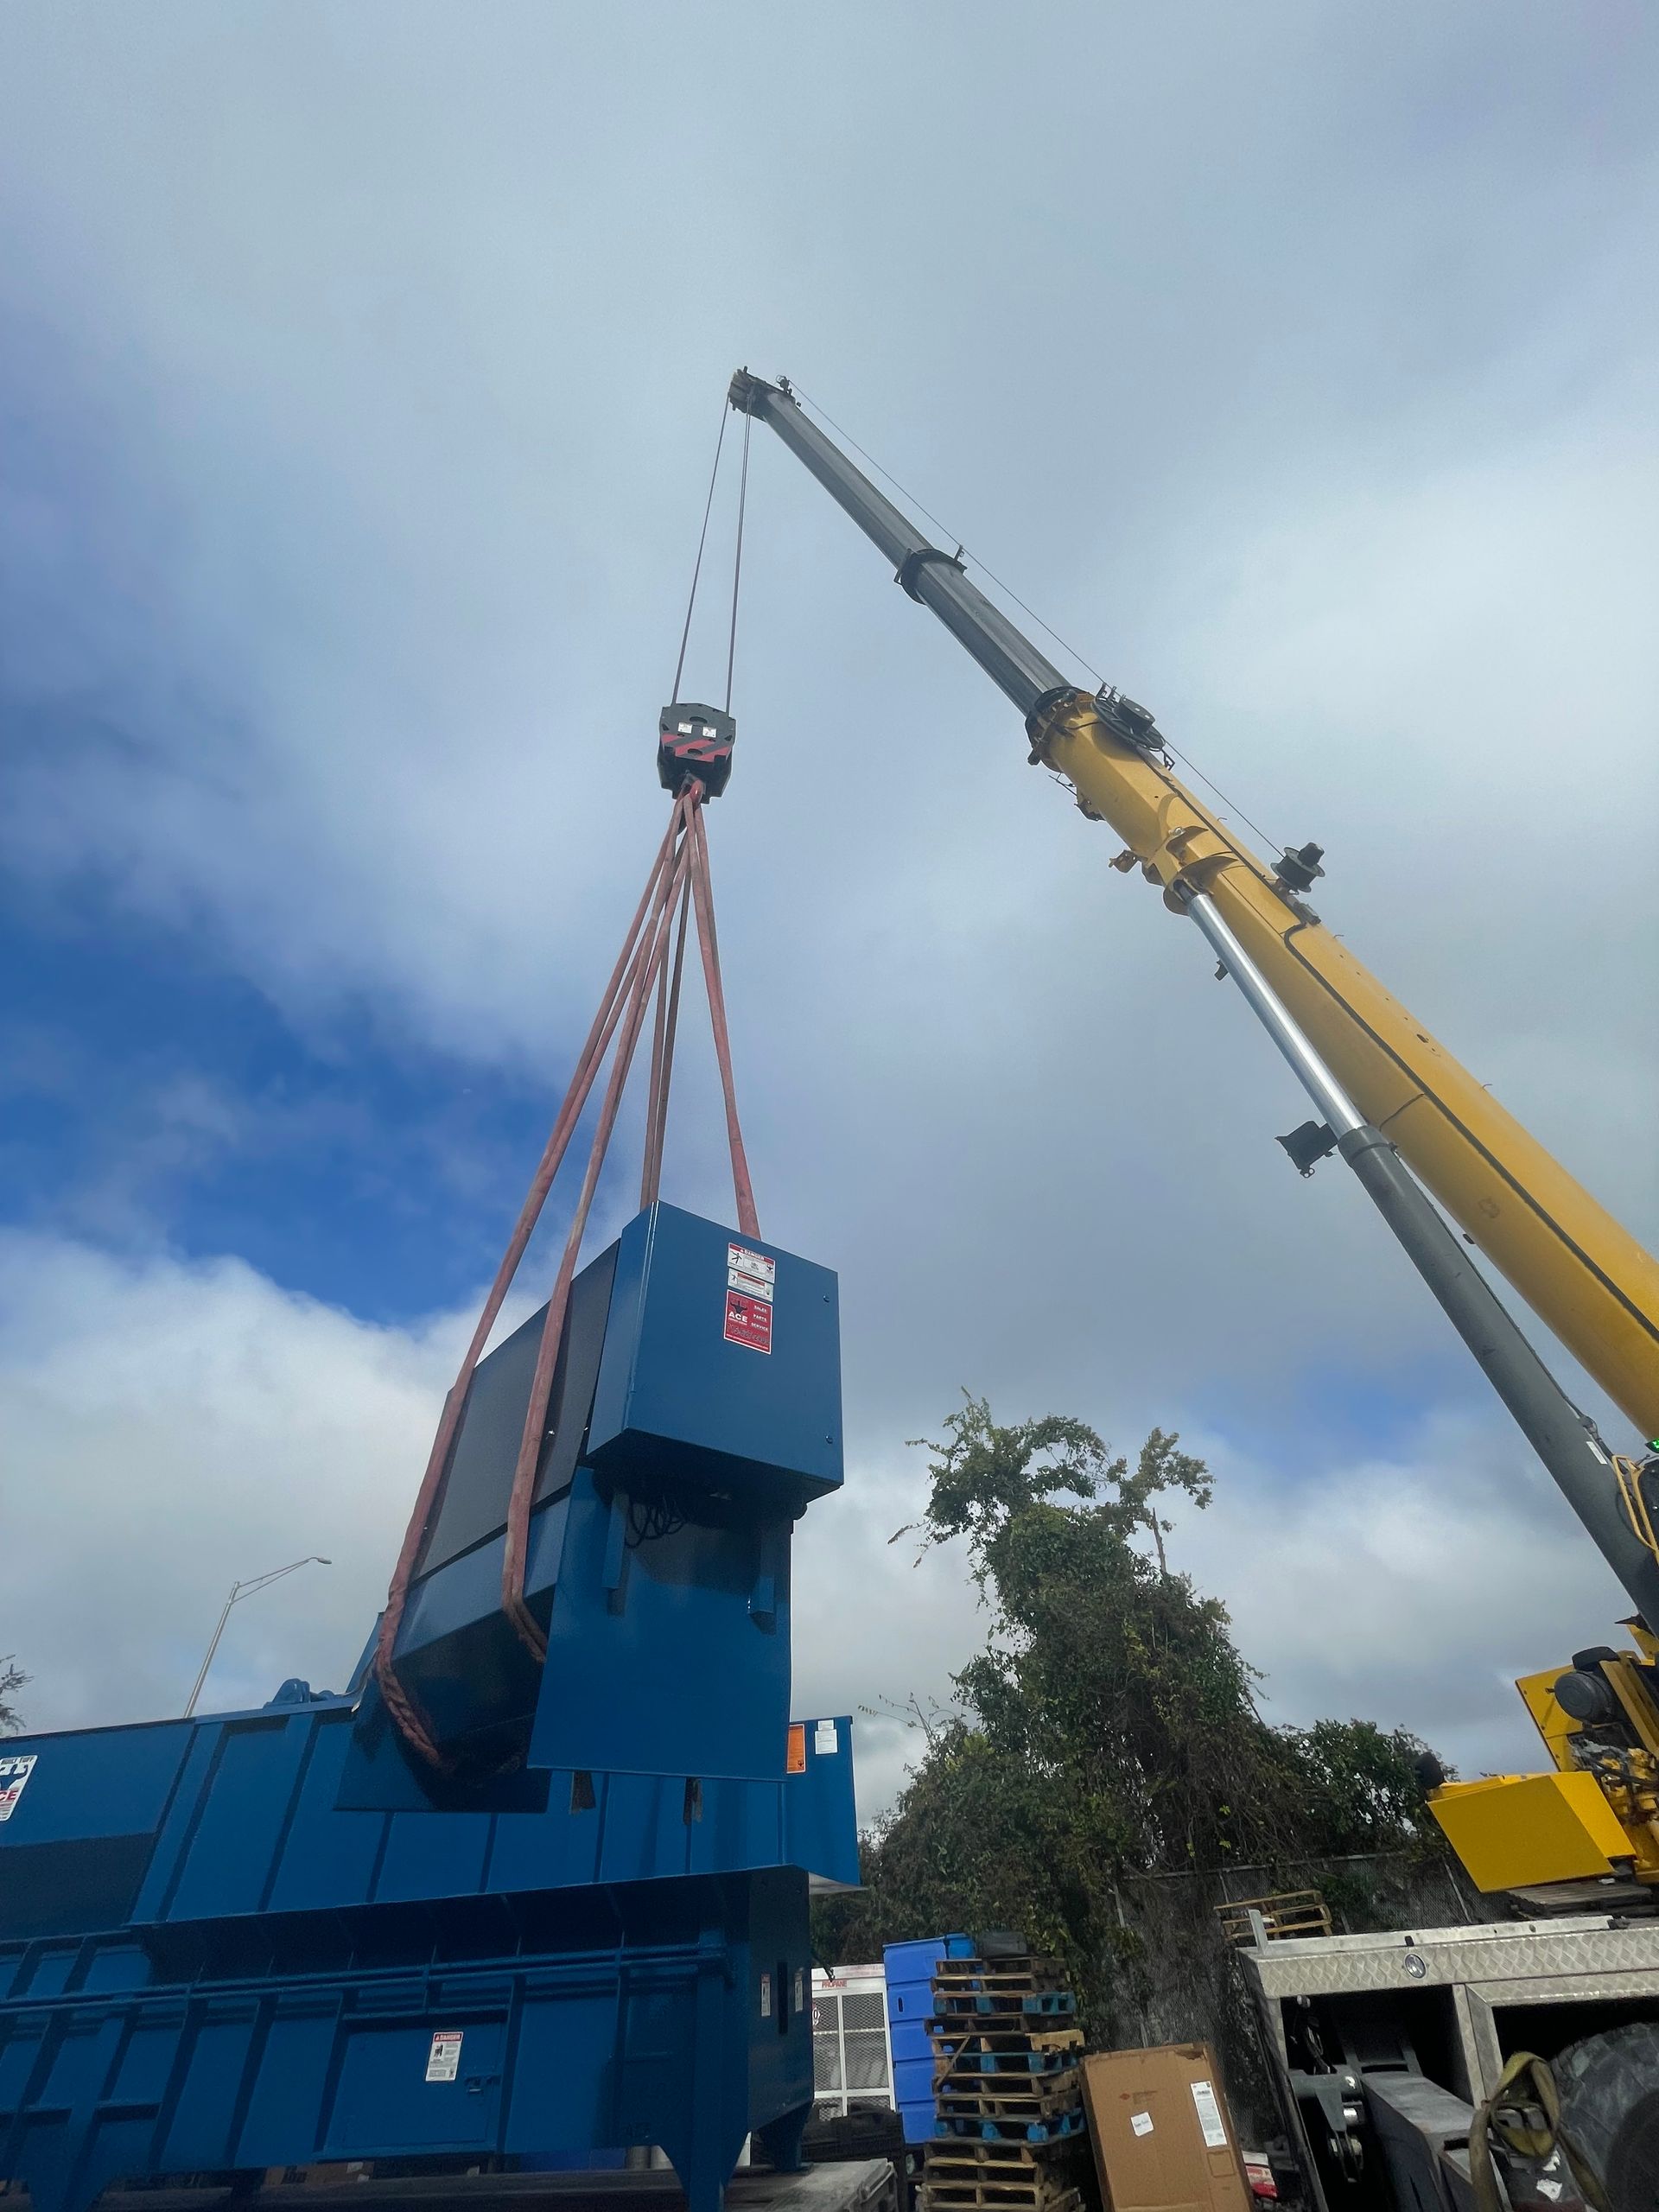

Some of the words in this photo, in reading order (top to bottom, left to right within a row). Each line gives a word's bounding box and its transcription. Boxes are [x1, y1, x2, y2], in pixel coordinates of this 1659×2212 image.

[744, 1249, 765, 1262] DANGER
[753, 1305, 767, 1313] SALES
[728, 1311, 748, 1323] ACE
[751, 1322, 769, 1332] SERVICE
[822, 1980, 848, 1988] PROPANE
